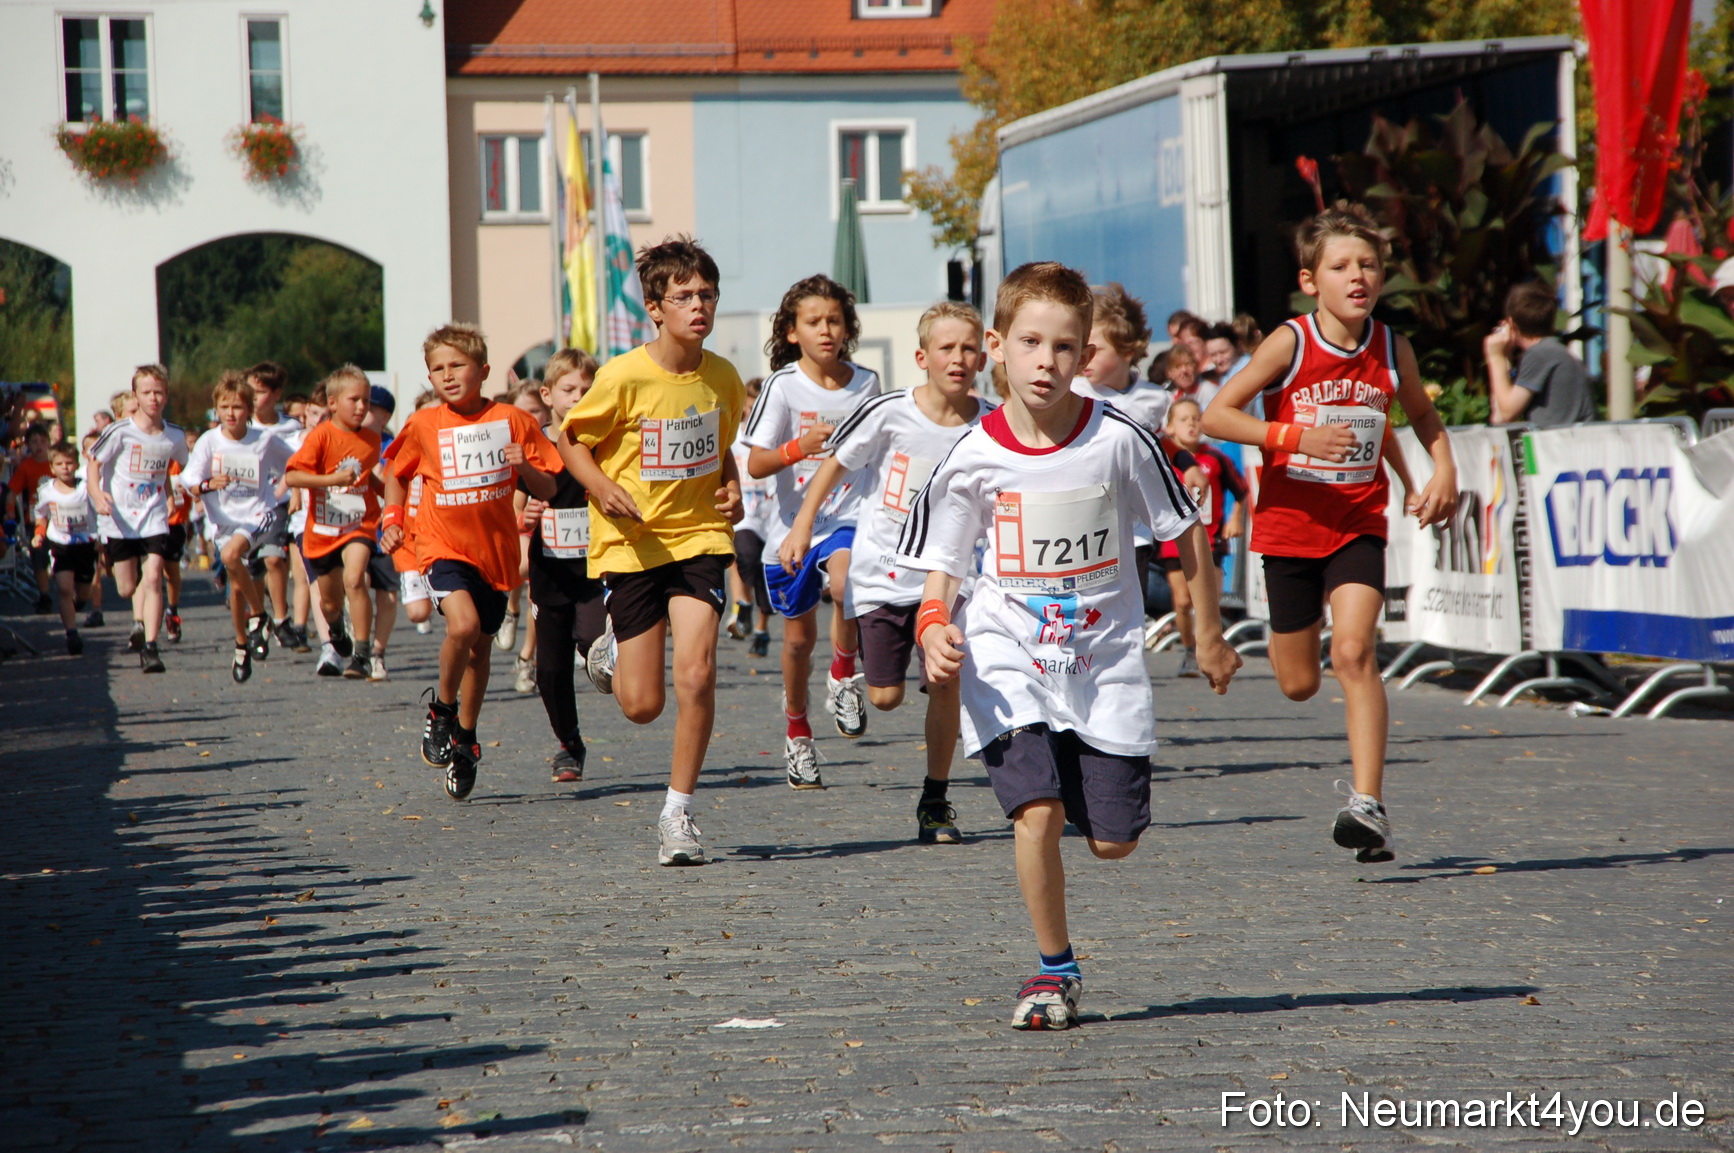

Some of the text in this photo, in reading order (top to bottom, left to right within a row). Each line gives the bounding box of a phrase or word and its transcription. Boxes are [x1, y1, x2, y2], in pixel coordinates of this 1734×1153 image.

[666, 415, 703, 431] Patrick
[457, 429, 492, 444] Patrick
[645, 438, 656, 447] K4
[668, 433, 715, 461] 7095
[461, 448, 507, 470] 7110
[1545, 466, 1679, 568] BOCK
[1032, 528, 1109, 565] 7217
[1000, 578, 1047, 587] BOCK
[1076, 565, 1119, 583] PFLEIDERER
